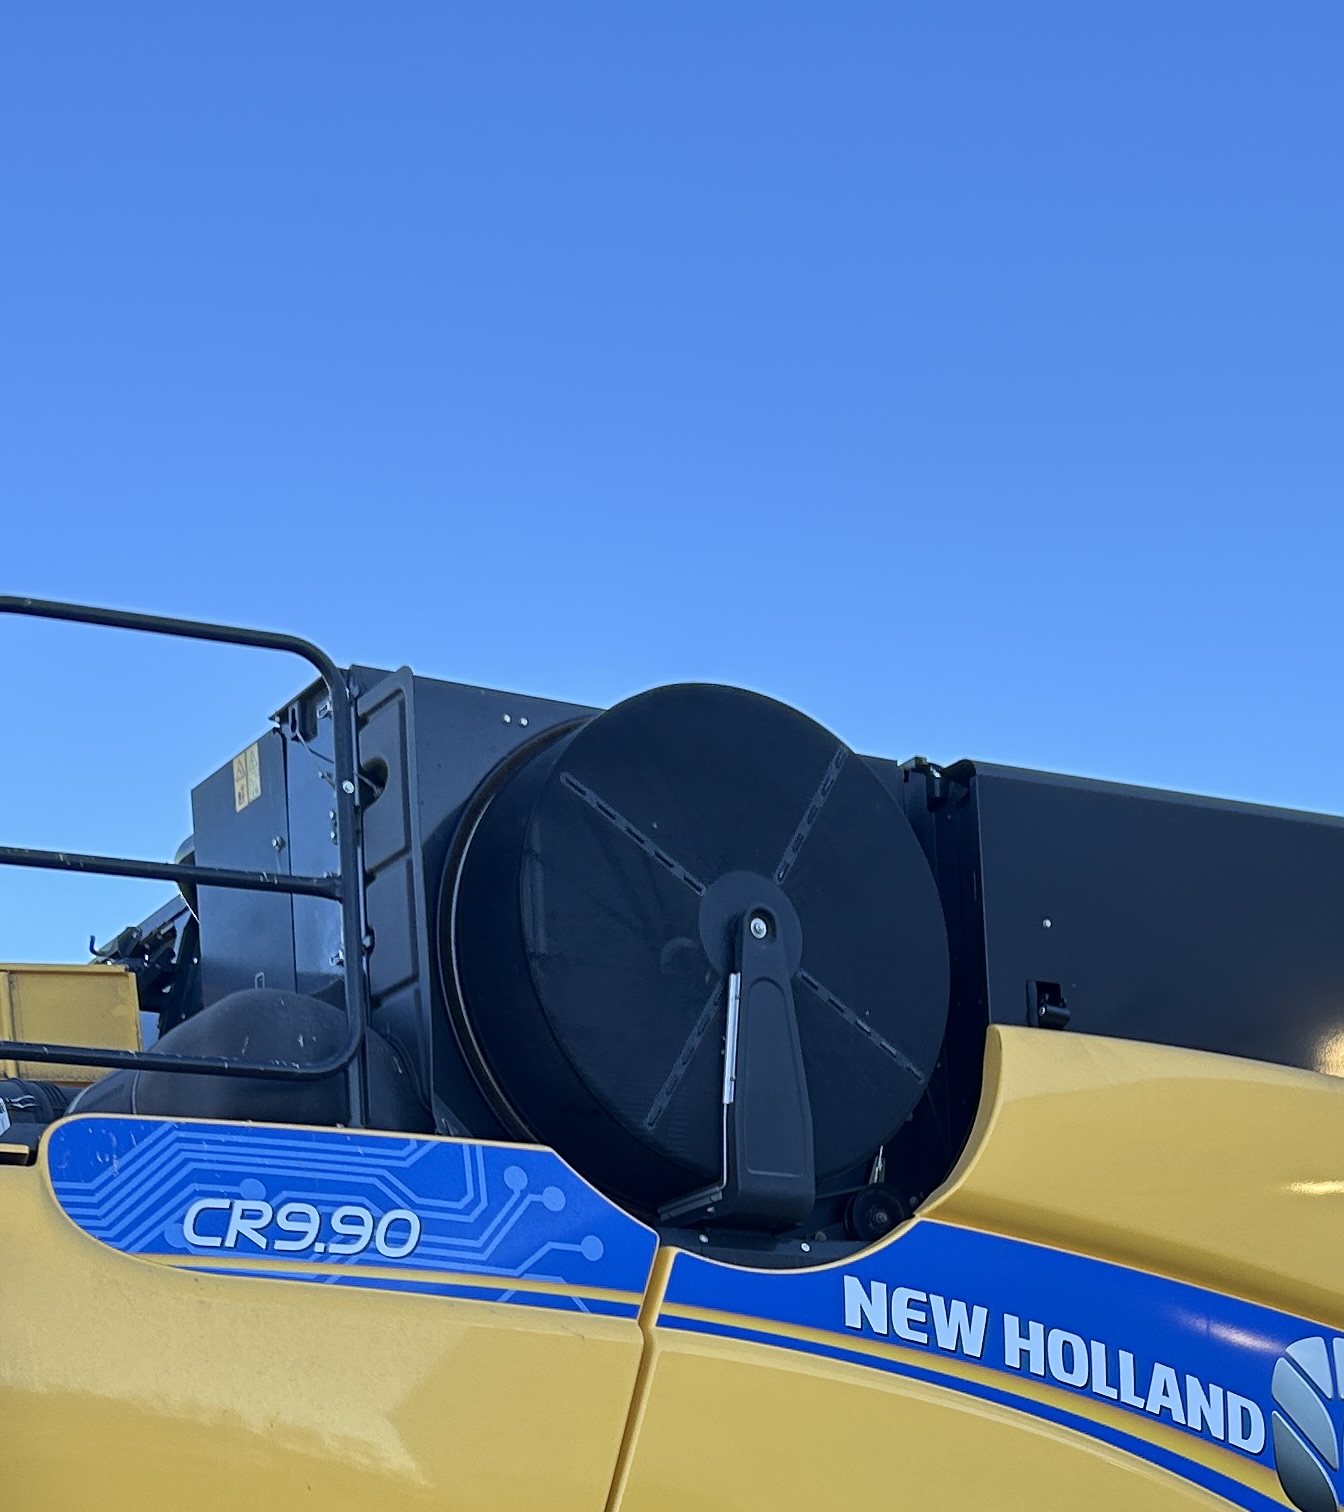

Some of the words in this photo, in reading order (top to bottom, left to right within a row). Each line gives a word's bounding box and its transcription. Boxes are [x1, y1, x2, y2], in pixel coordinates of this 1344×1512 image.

[183, 1198, 421, 1258] CR9.90
[843, 1275, 988, 1358] NEW
[1003, 1314, 1266, 1455] HOLLAND
